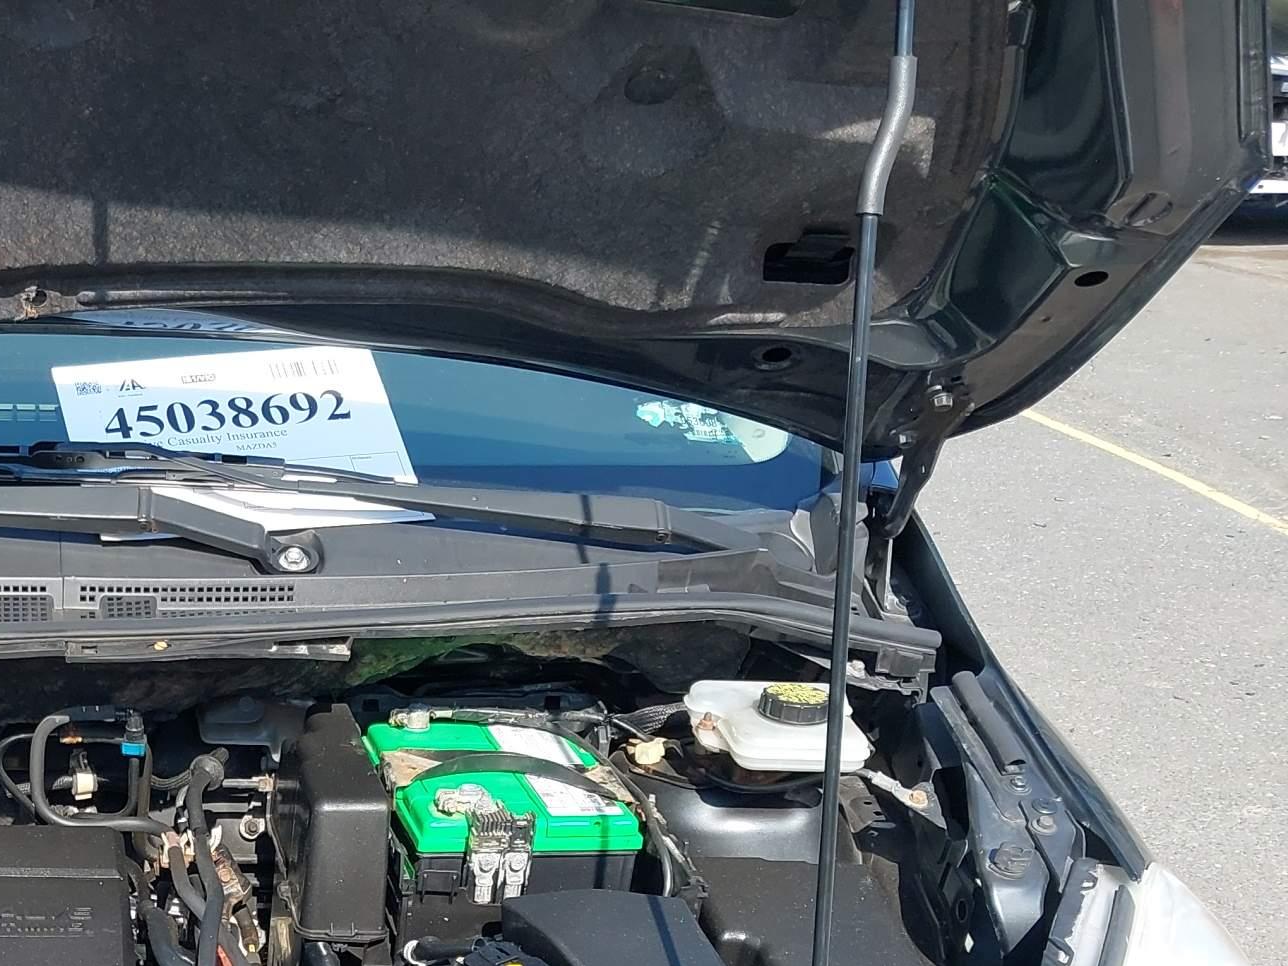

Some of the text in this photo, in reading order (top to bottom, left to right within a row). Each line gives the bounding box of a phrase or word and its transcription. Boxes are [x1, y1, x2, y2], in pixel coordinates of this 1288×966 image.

[105, 390, 352, 439] 45038692
[167, 433, 223, 447] Casualty
[226, 428, 289, 442] Insurance
